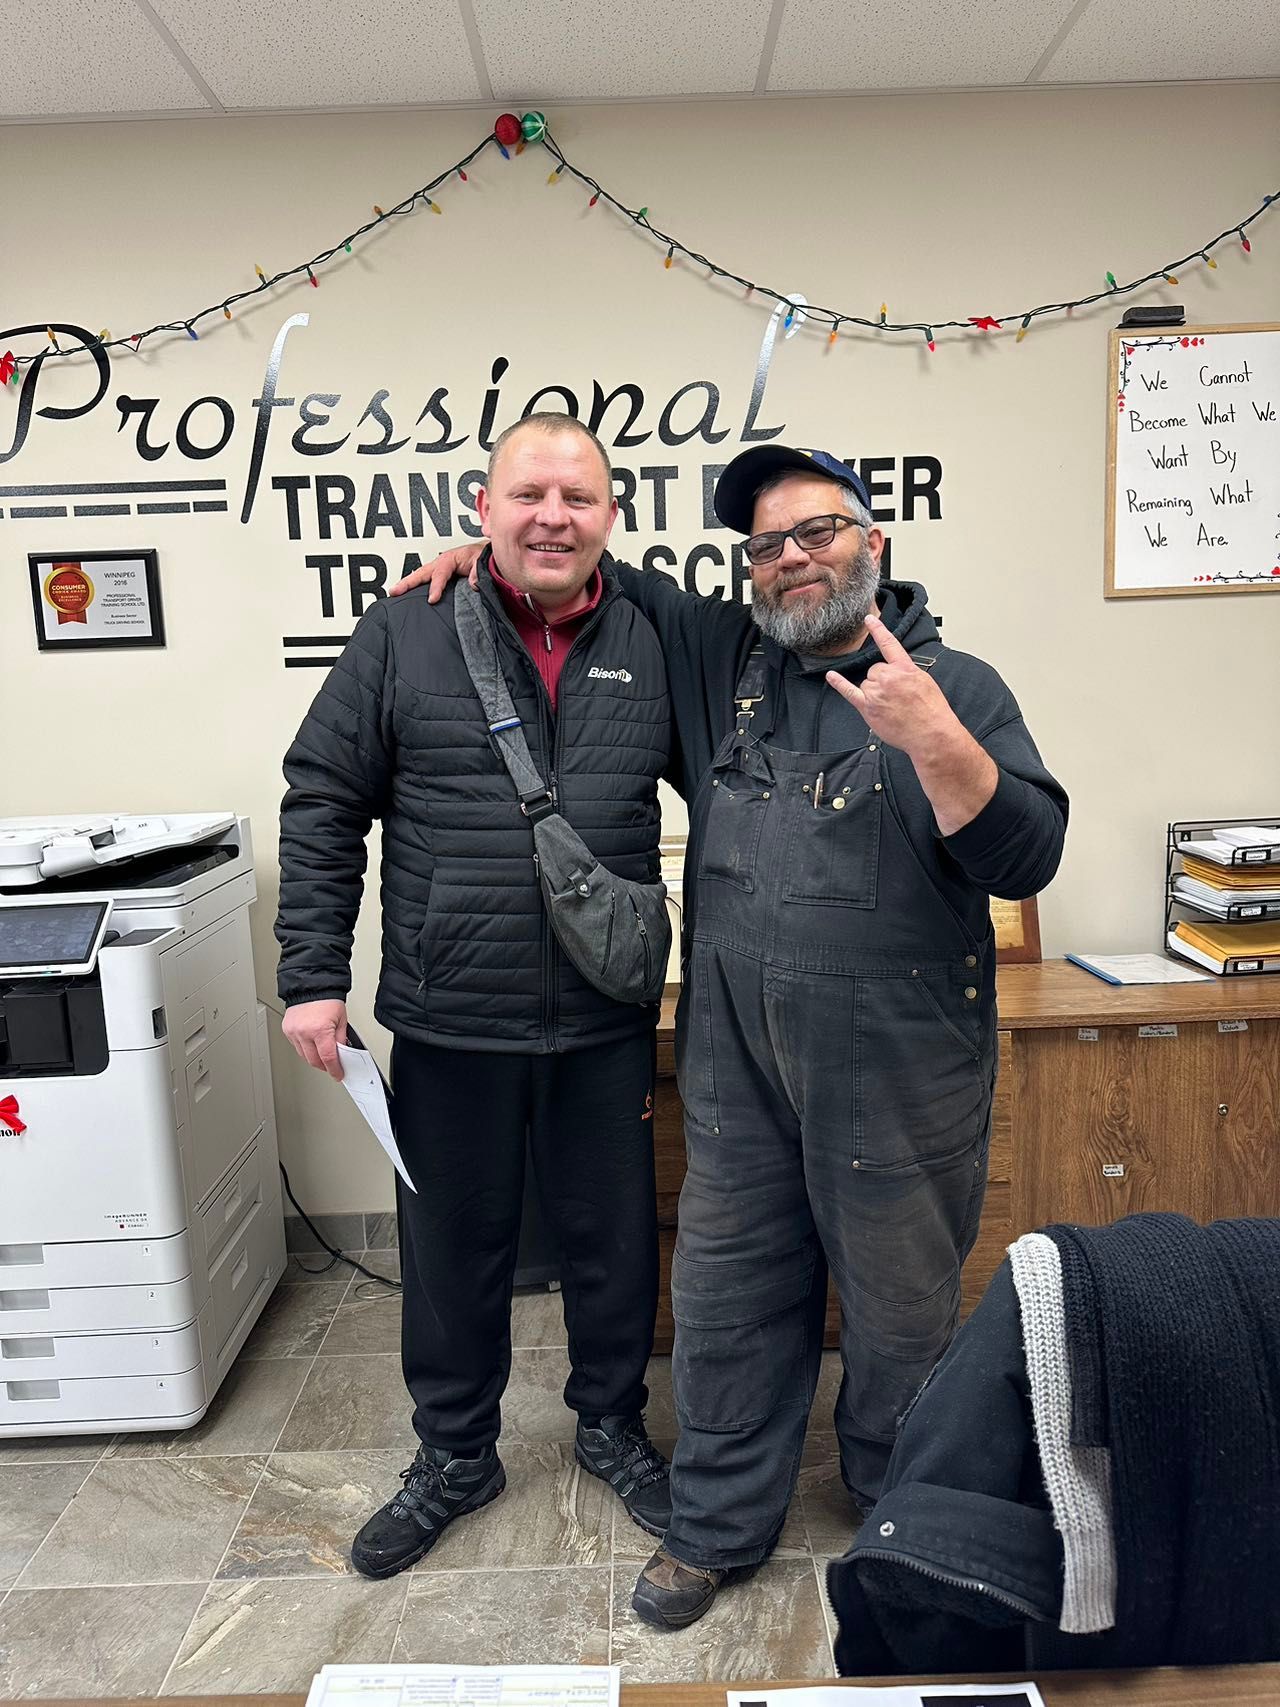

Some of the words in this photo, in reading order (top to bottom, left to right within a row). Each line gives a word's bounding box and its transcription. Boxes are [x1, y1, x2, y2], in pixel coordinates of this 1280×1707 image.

[1141, 370, 1169, 392] We
[1199, 360, 1253, 387] Cannot
[1129, 410, 1188, 433] Become
[1198, 402, 1236, 426] What
[1252, 401, 1277, 422] We
[1147, 444, 1189, 470] Want
[1210, 440, 1237, 473] By
[272, 465, 679, 541] TRANSRT
[1126, 488, 1194, 516] Remaining
[1209, 479, 1254, 506] What
[1144, 522, 1169, 548] We
[587, 666, 626, 681] Bison
